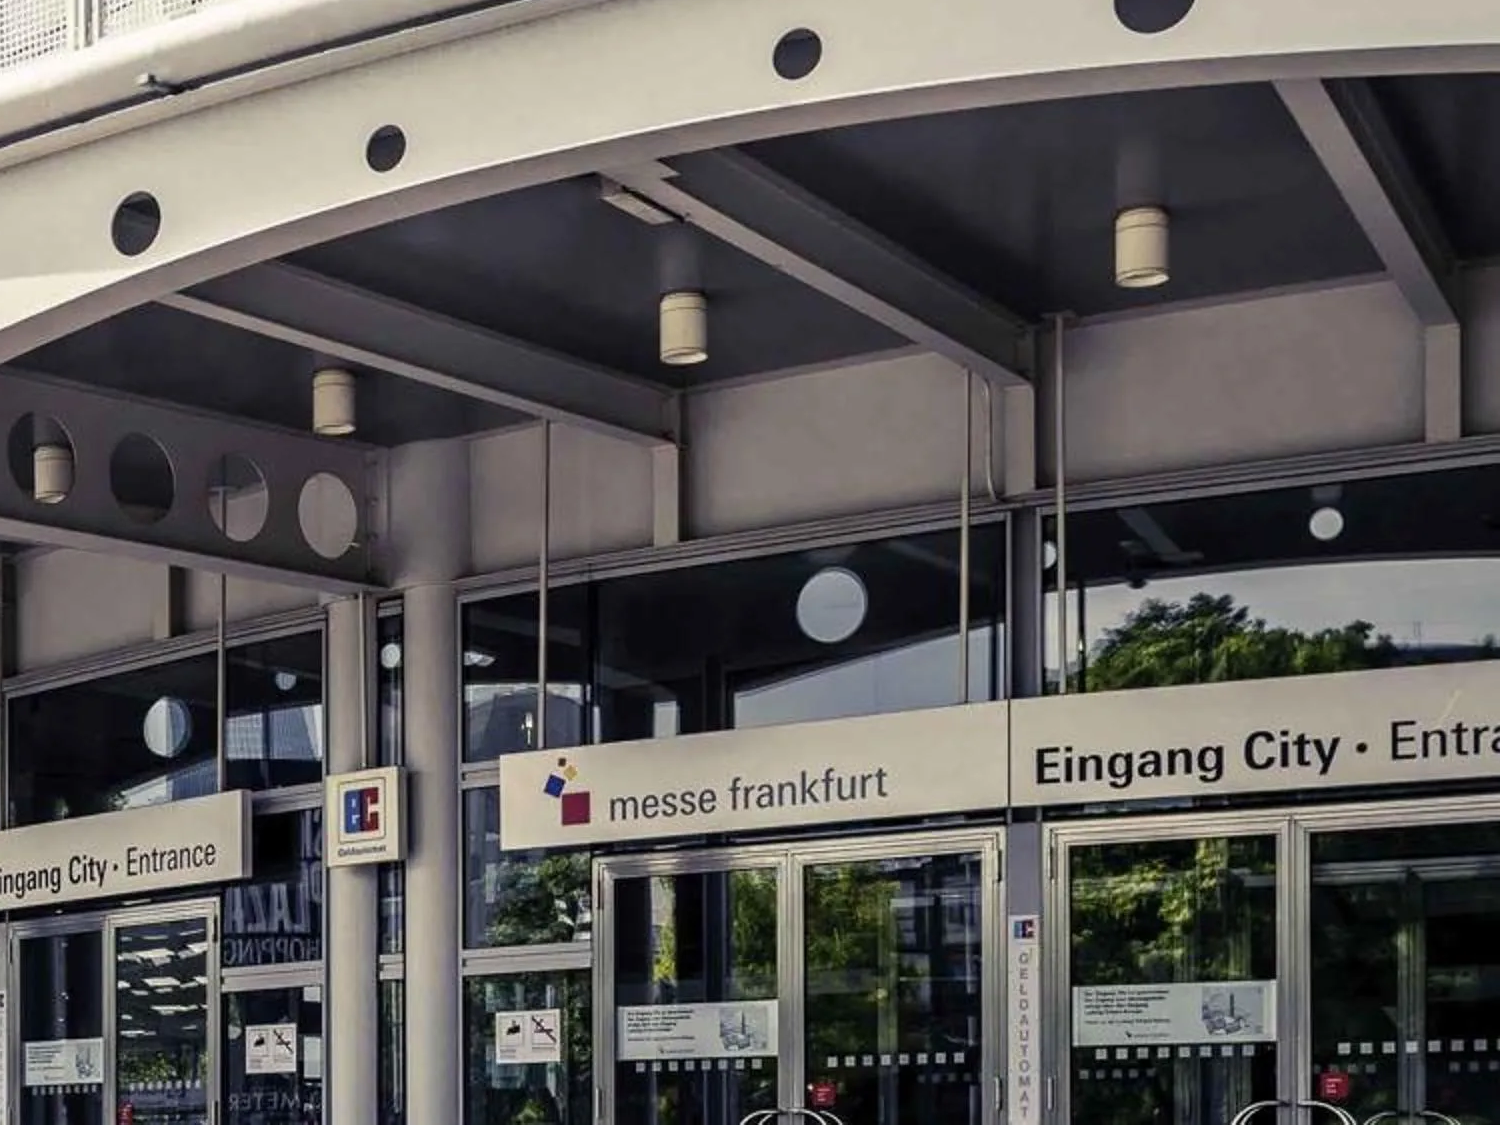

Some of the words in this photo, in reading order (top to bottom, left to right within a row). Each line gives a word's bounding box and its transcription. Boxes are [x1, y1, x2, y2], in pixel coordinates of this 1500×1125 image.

[1035, 744, 1225, 789] Eingang
[1243, 729, 1341, 775] City
[609, 787, 717, 822] messe
[729, 767, 888, 811] frankfurt
[68, 854, 109, 887] City
[127, 842, 217, 877] Entrance
[1018, 952, 1031, 1118] GELDAUTOMAT
